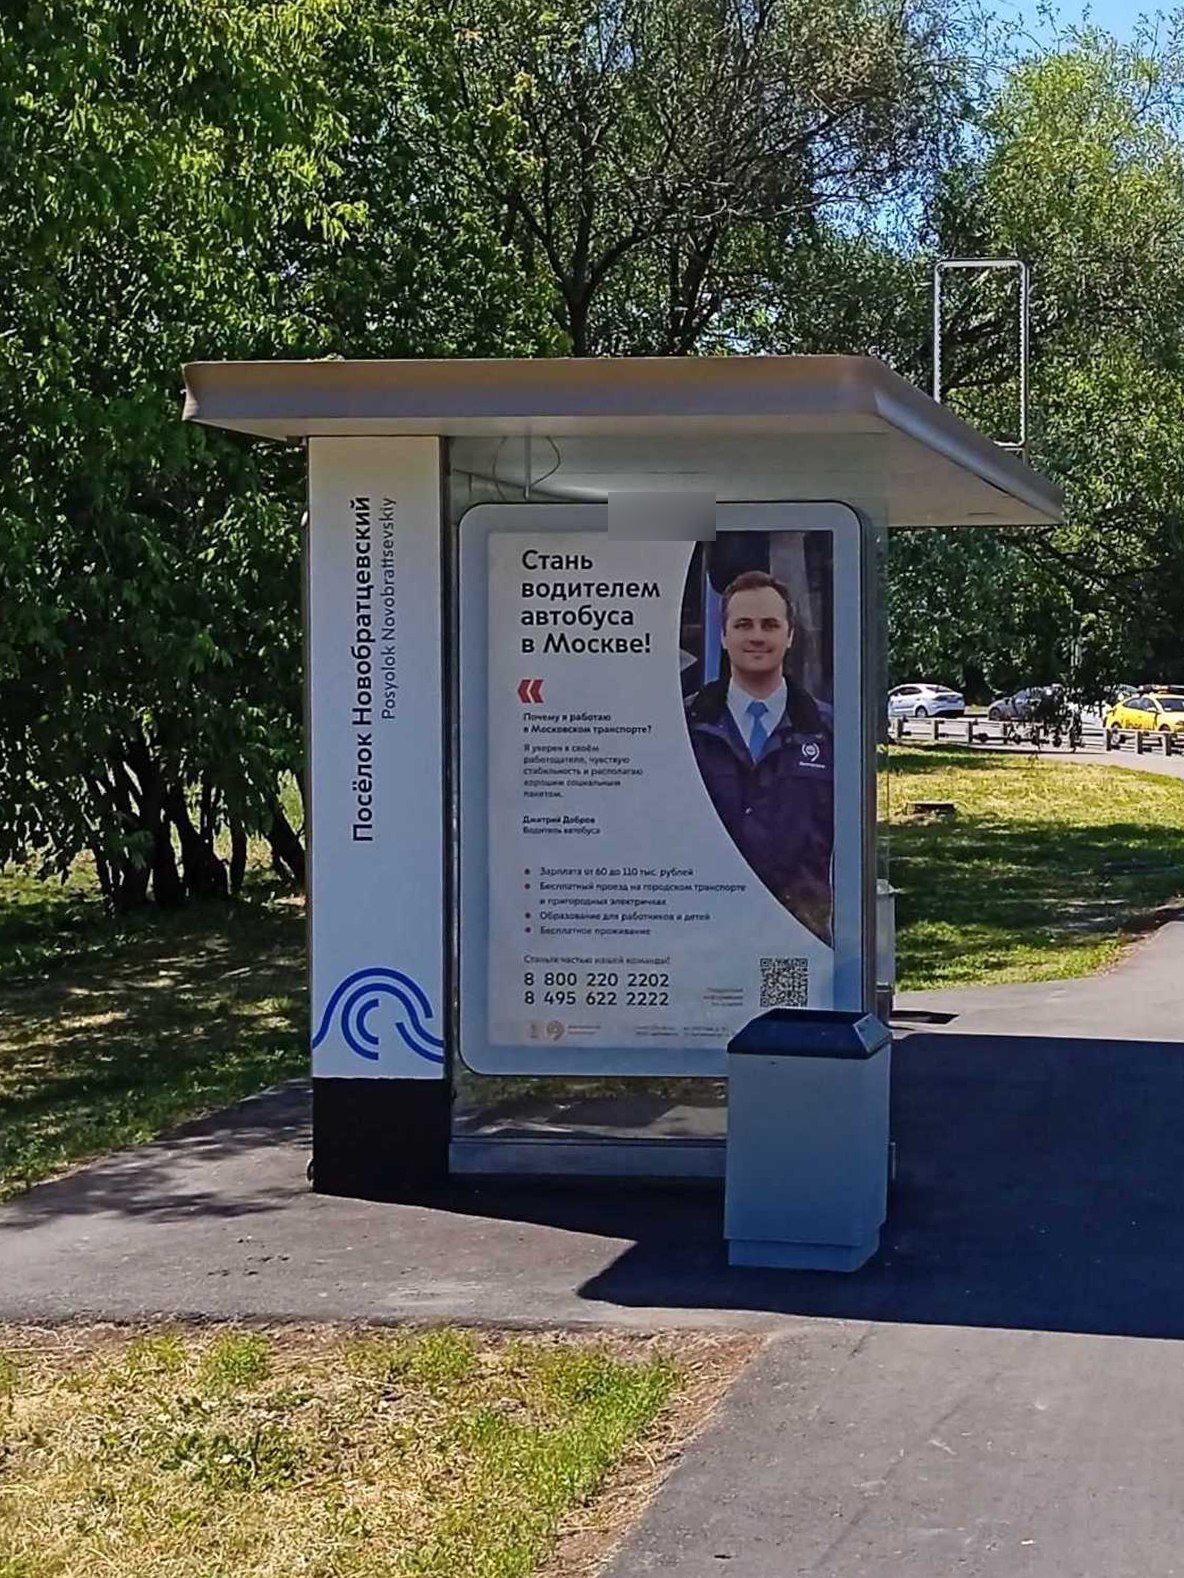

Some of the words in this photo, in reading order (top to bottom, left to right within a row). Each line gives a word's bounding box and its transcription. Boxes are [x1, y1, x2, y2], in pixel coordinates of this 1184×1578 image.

[522, 549, 593, 570] Стань
[521, 582, 660, 601] водителем
[350, 496, 375, 725] Новобратцевский
[521, 604, 634, 631] автобуса
[522, 638, 535, 653] в
[543, 632, 651, 653] Москве!
[381, 647, 399, 720] Posyolok
[523, 712, 560, 722] Почему
[570, 711, 611, 722] работаю
[531, 725, 591, 733] Московском
[593, 725, 652, 734] транспорте?
[351, 733, 374, 842] Посёлок
[523, 815, 561, 825] Дмитрий
[540, 867, 582, 876] Зарплата
[595, 867, 607, 876] 60
[609, 868, 621, 876] до
[622, 867, 638, 876] 110
[660, 867, 693, 878] рублей
[540, 881, 594, 890] Бесплатный
[596, 883, 628, 891] проезд
[643, 884, 693, 892] городском
[694, 884, 746, 892] транспорте
[540, 911, 601, 920] Образование
[684, 913, 711, 921] детей
[524, 972, 535, 986] 8
[543, 972, 578, 986] 800
[586, 972, 619, 987] 220
[627, 973, 669, 987] 2202
[524, 991, 535, 1005] 8
[544, 991, 576, 1005] 495
[586, 991, 617, 1006] 622
[626, 991, 669, 1006] 2222
